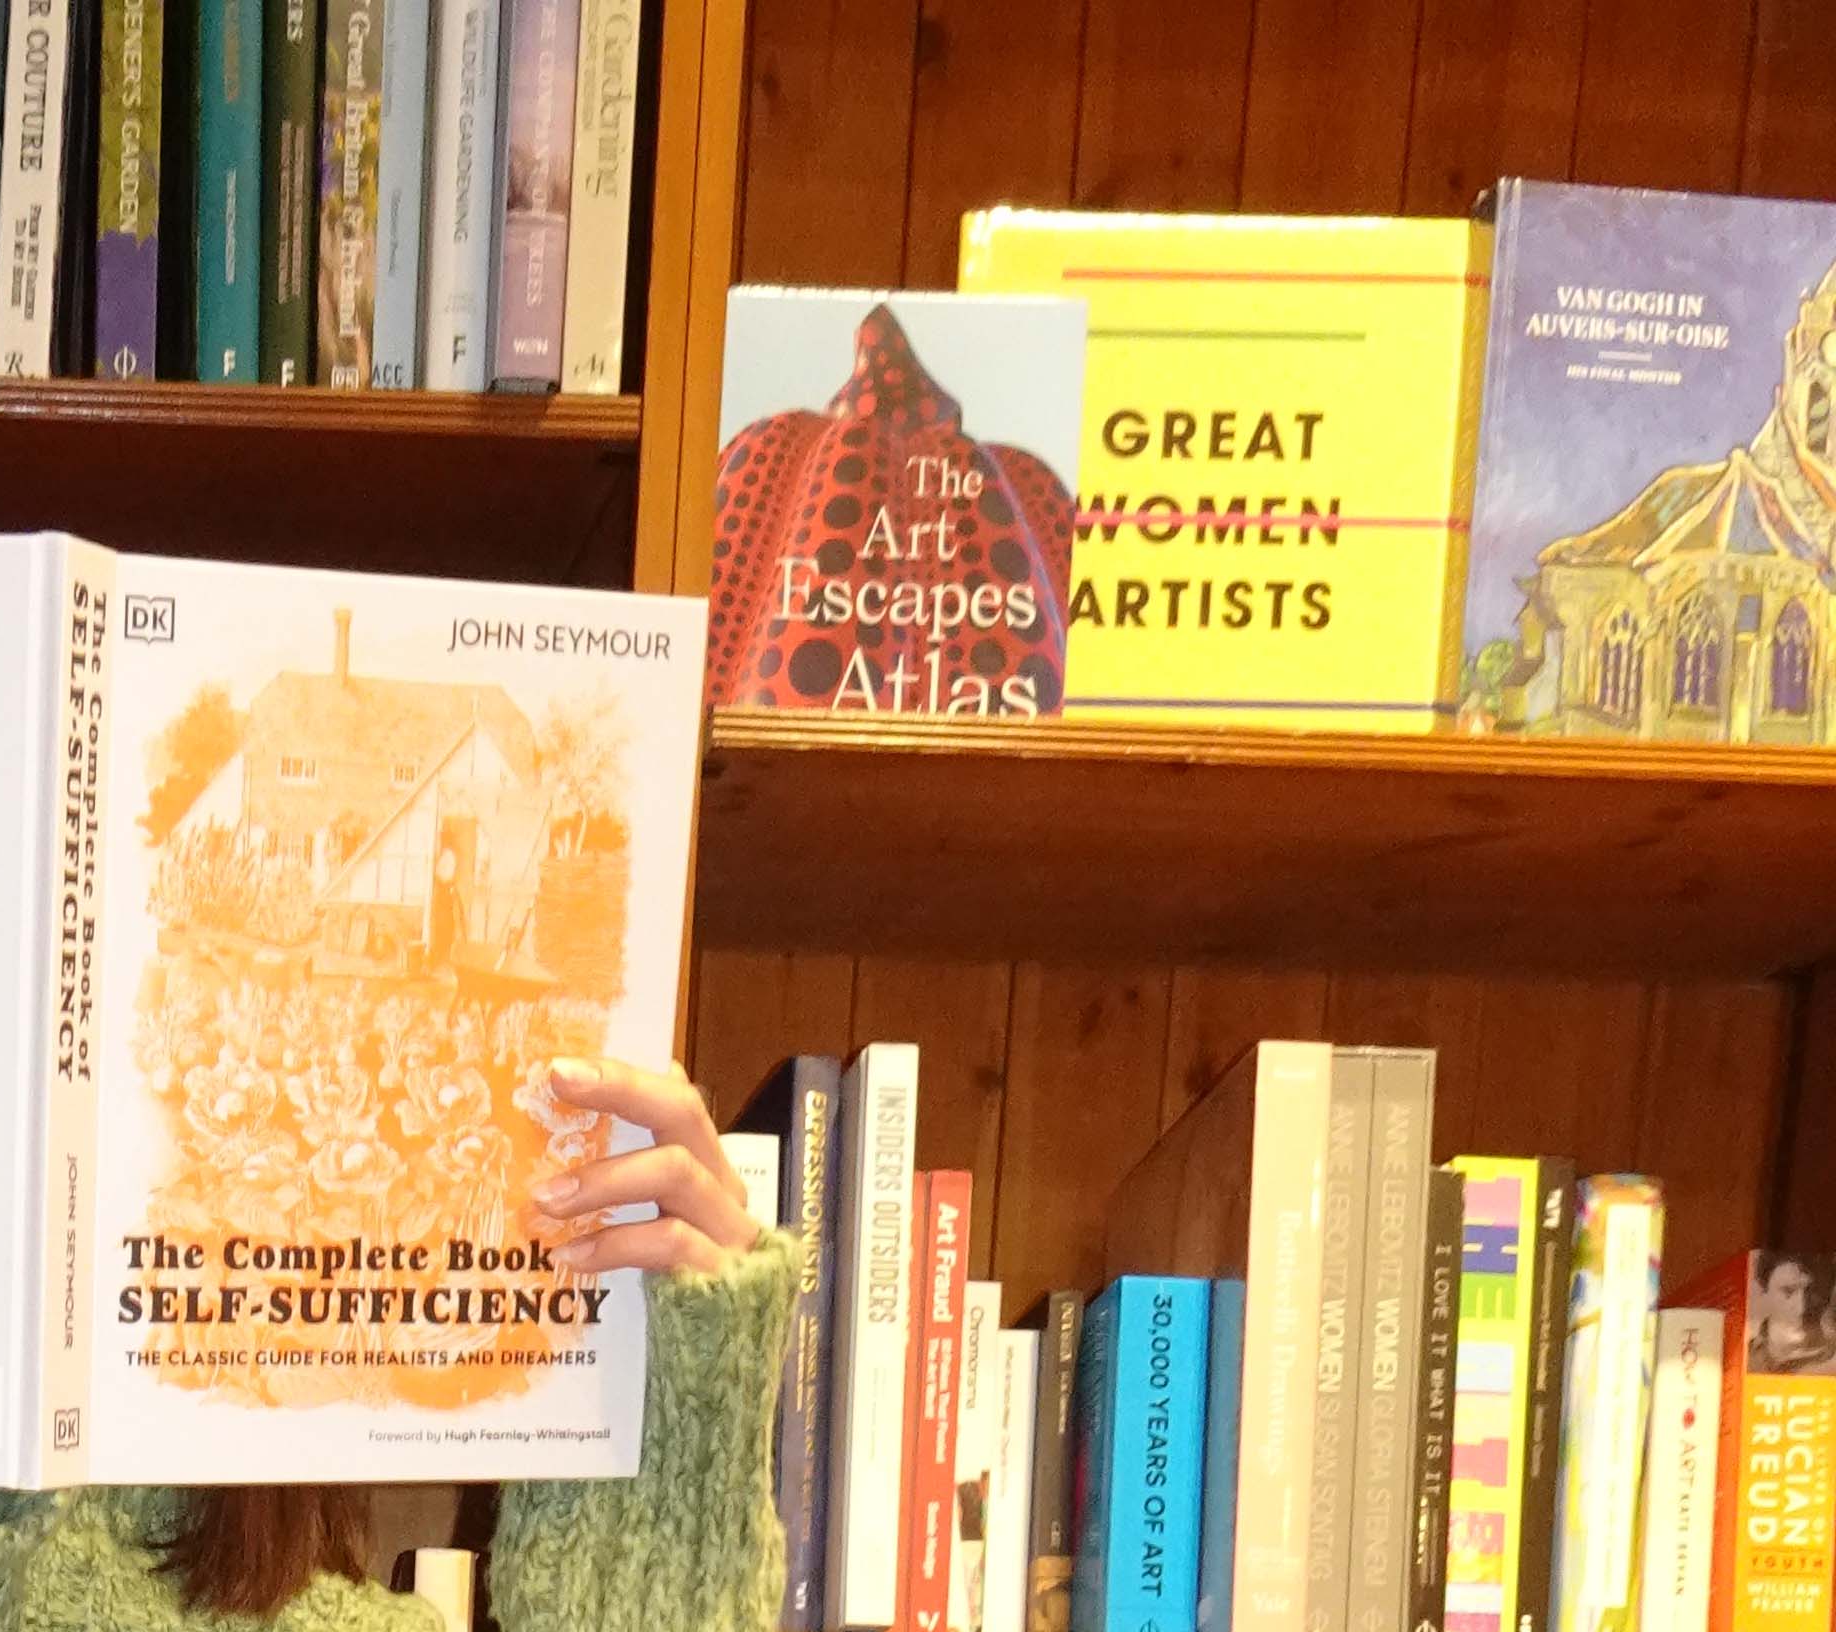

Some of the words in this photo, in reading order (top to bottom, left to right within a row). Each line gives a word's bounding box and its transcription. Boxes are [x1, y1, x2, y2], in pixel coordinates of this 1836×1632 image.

[20, 29, 50, 172] COUTURE
[1555, 286, 1601, 312] VAN
[1606, 290, 1673, 316] GOGH
[1677, 294, 1703, 319] IN
[1525, 314, 1729, 348] AUVERS-SUR-OISE
[1104, 411, 1324, 461] GREAT
[907, 454, 983, 500] The
[860, 505, 957, 558] Art
[1074, 496, 1341, 545] WOMEN
[775, 558, 1037, 630] Escapes
[1068, 581, 1331, 629] ARTISTS
[90, 592, 107, 675] The
[447, 617, 524, 652] JOHN
[534, 623, 672, 661] SEYMOUR
[832, 648, 1037, 717] Atlas
[82, 694, 104, 899] Complete
[57, 581, 90, 1082] SELF-SUFFICIENCY
[79, 916, 97, 1026] Book
[77, 1036, 92, 1083] of
[874, 1086, 907, 1194] INSIDERS
[936, 1202, 958, 1245] Art
[124, 1236, 205, 1270] The
[224, 1237, 429, 1279] Complete
[447, 1238, 553, 1273] Book
[869, 1202, 900, 1325] OUTSIDERS
[117, 1286, 611, 1326] SELF-SUFFICIENCY
[932, 1248, 955, 1323] Fraud
[125, 1349, 160, 1366] THE
[168, 1349, 248, 1367] CLASSIC
[255, 1349, 313, 1367] GUIDE
[320, 1349, 357, 1367] FOR
[365, 1349, 448, 1367] REALISTS
[454, 1349, 494, 1367] AND
[501, 1349, 597, 1367] DREAMERS
[1149, 1295, 1173, 1389] 30,000
[368, 1428, 422, 1443] Foreword
[426, 1428, 442, 1445] by
[444, 1428, 477, 1445] Hugh
[1146, 1398, 1169, 1487] YEARS
[1144, 1491, 1167, 1534] OF
[1140, 1542, 1163, 1598] ART
